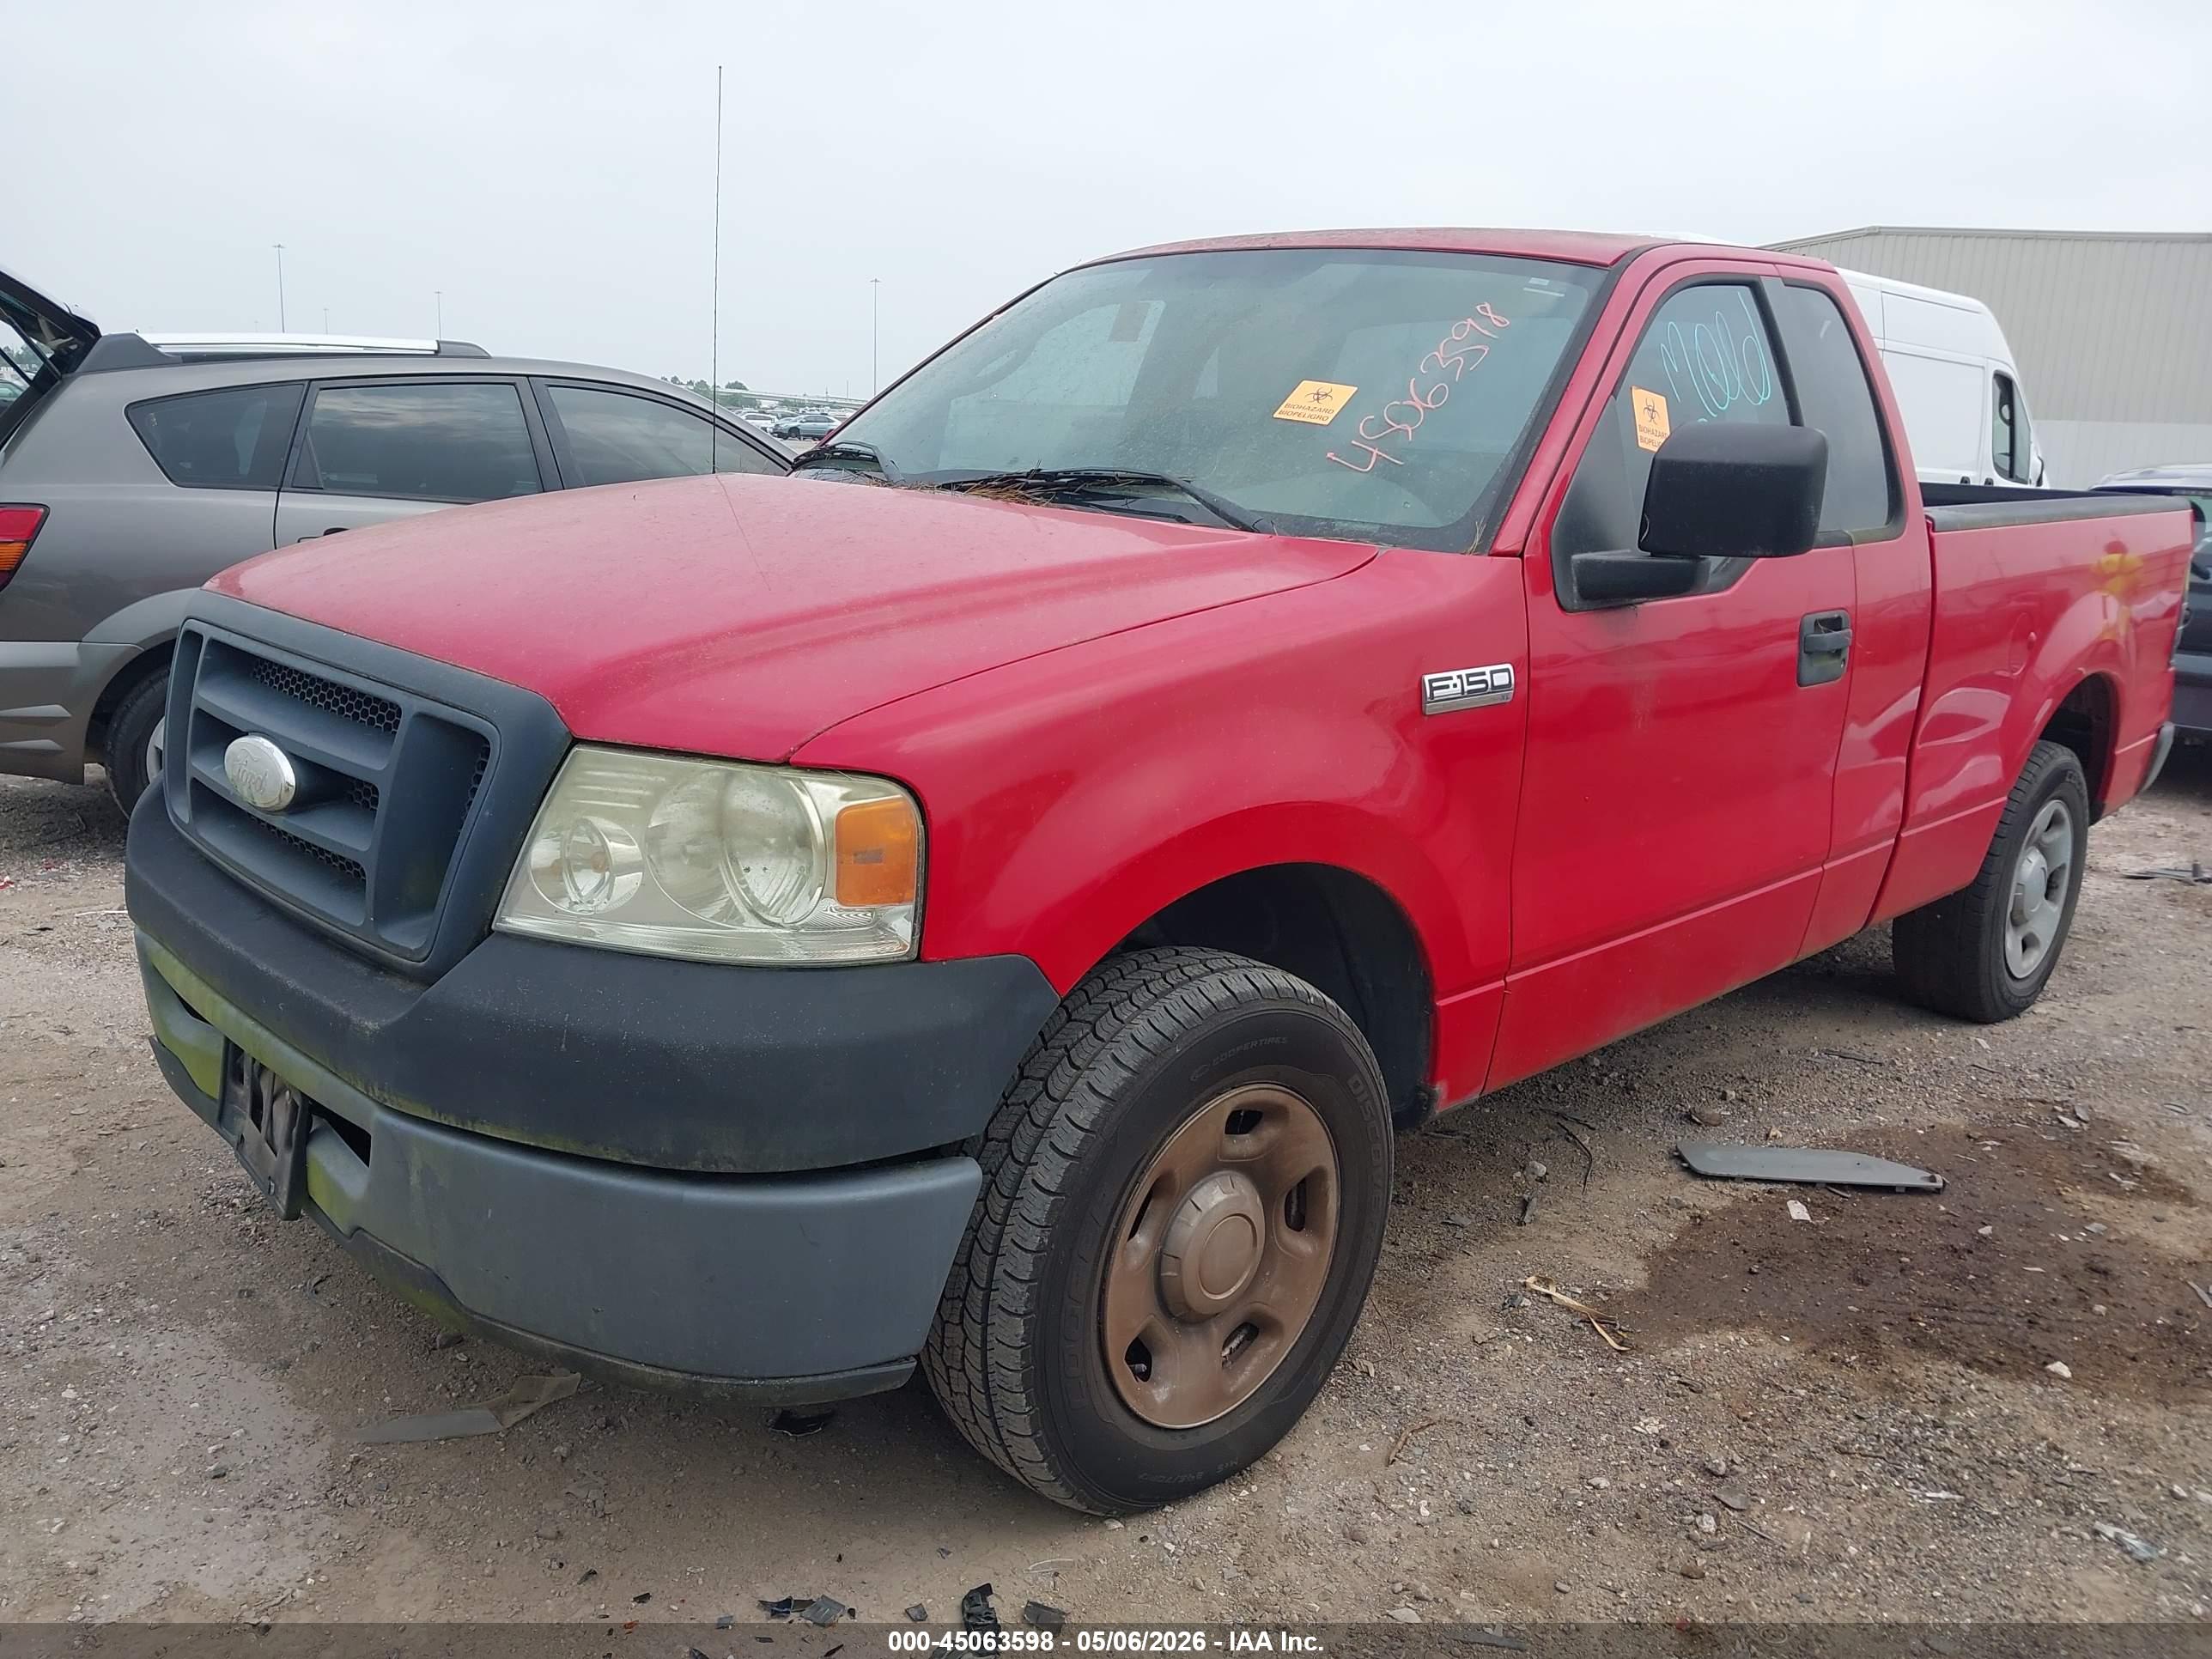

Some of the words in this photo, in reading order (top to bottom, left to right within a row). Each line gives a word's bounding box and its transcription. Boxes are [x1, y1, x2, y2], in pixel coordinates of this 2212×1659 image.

[1325, 301, 1510, 473] 45063598
[1278, 409, 1329, 422] BIOPELIGRO
[1284, 403, 1335, 415] BIOHAZARD
[232, 747, 270, 795] Ford
